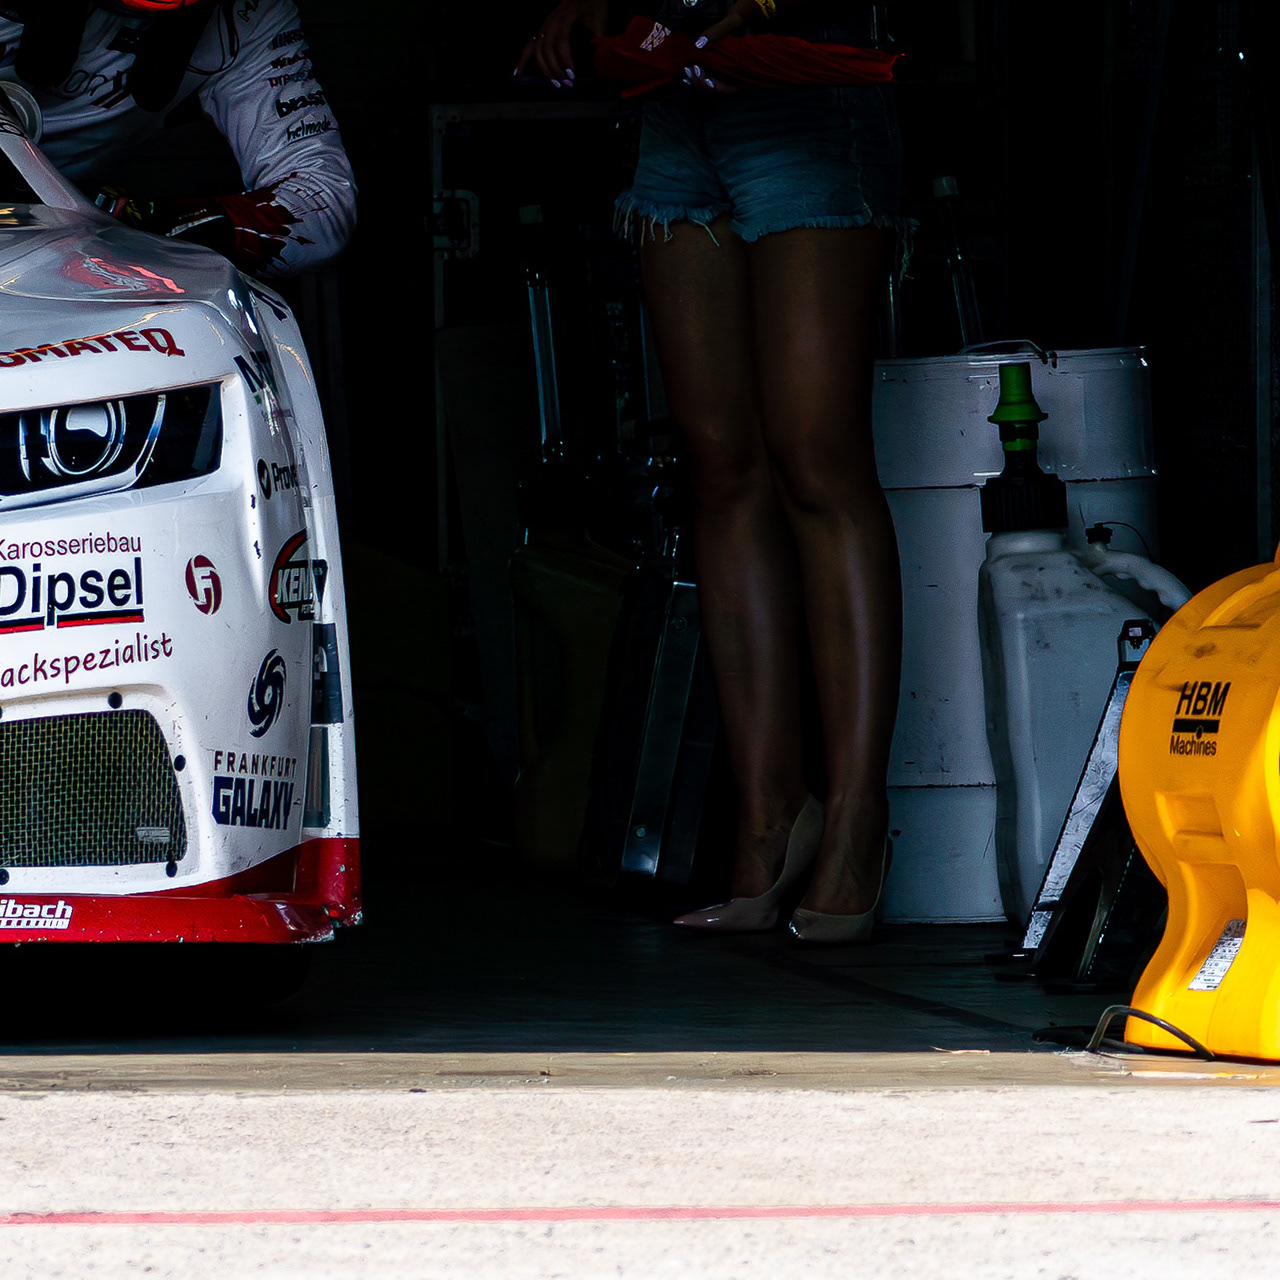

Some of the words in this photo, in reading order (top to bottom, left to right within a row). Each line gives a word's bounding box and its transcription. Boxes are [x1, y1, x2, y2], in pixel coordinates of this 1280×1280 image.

[1175, 680, 1232, 717] HBM
[1169, 734, 1218, 757] Machines
[213, 749, 298, 777] FRANKFURT
[212, 775, 297, 830] GALAXY
